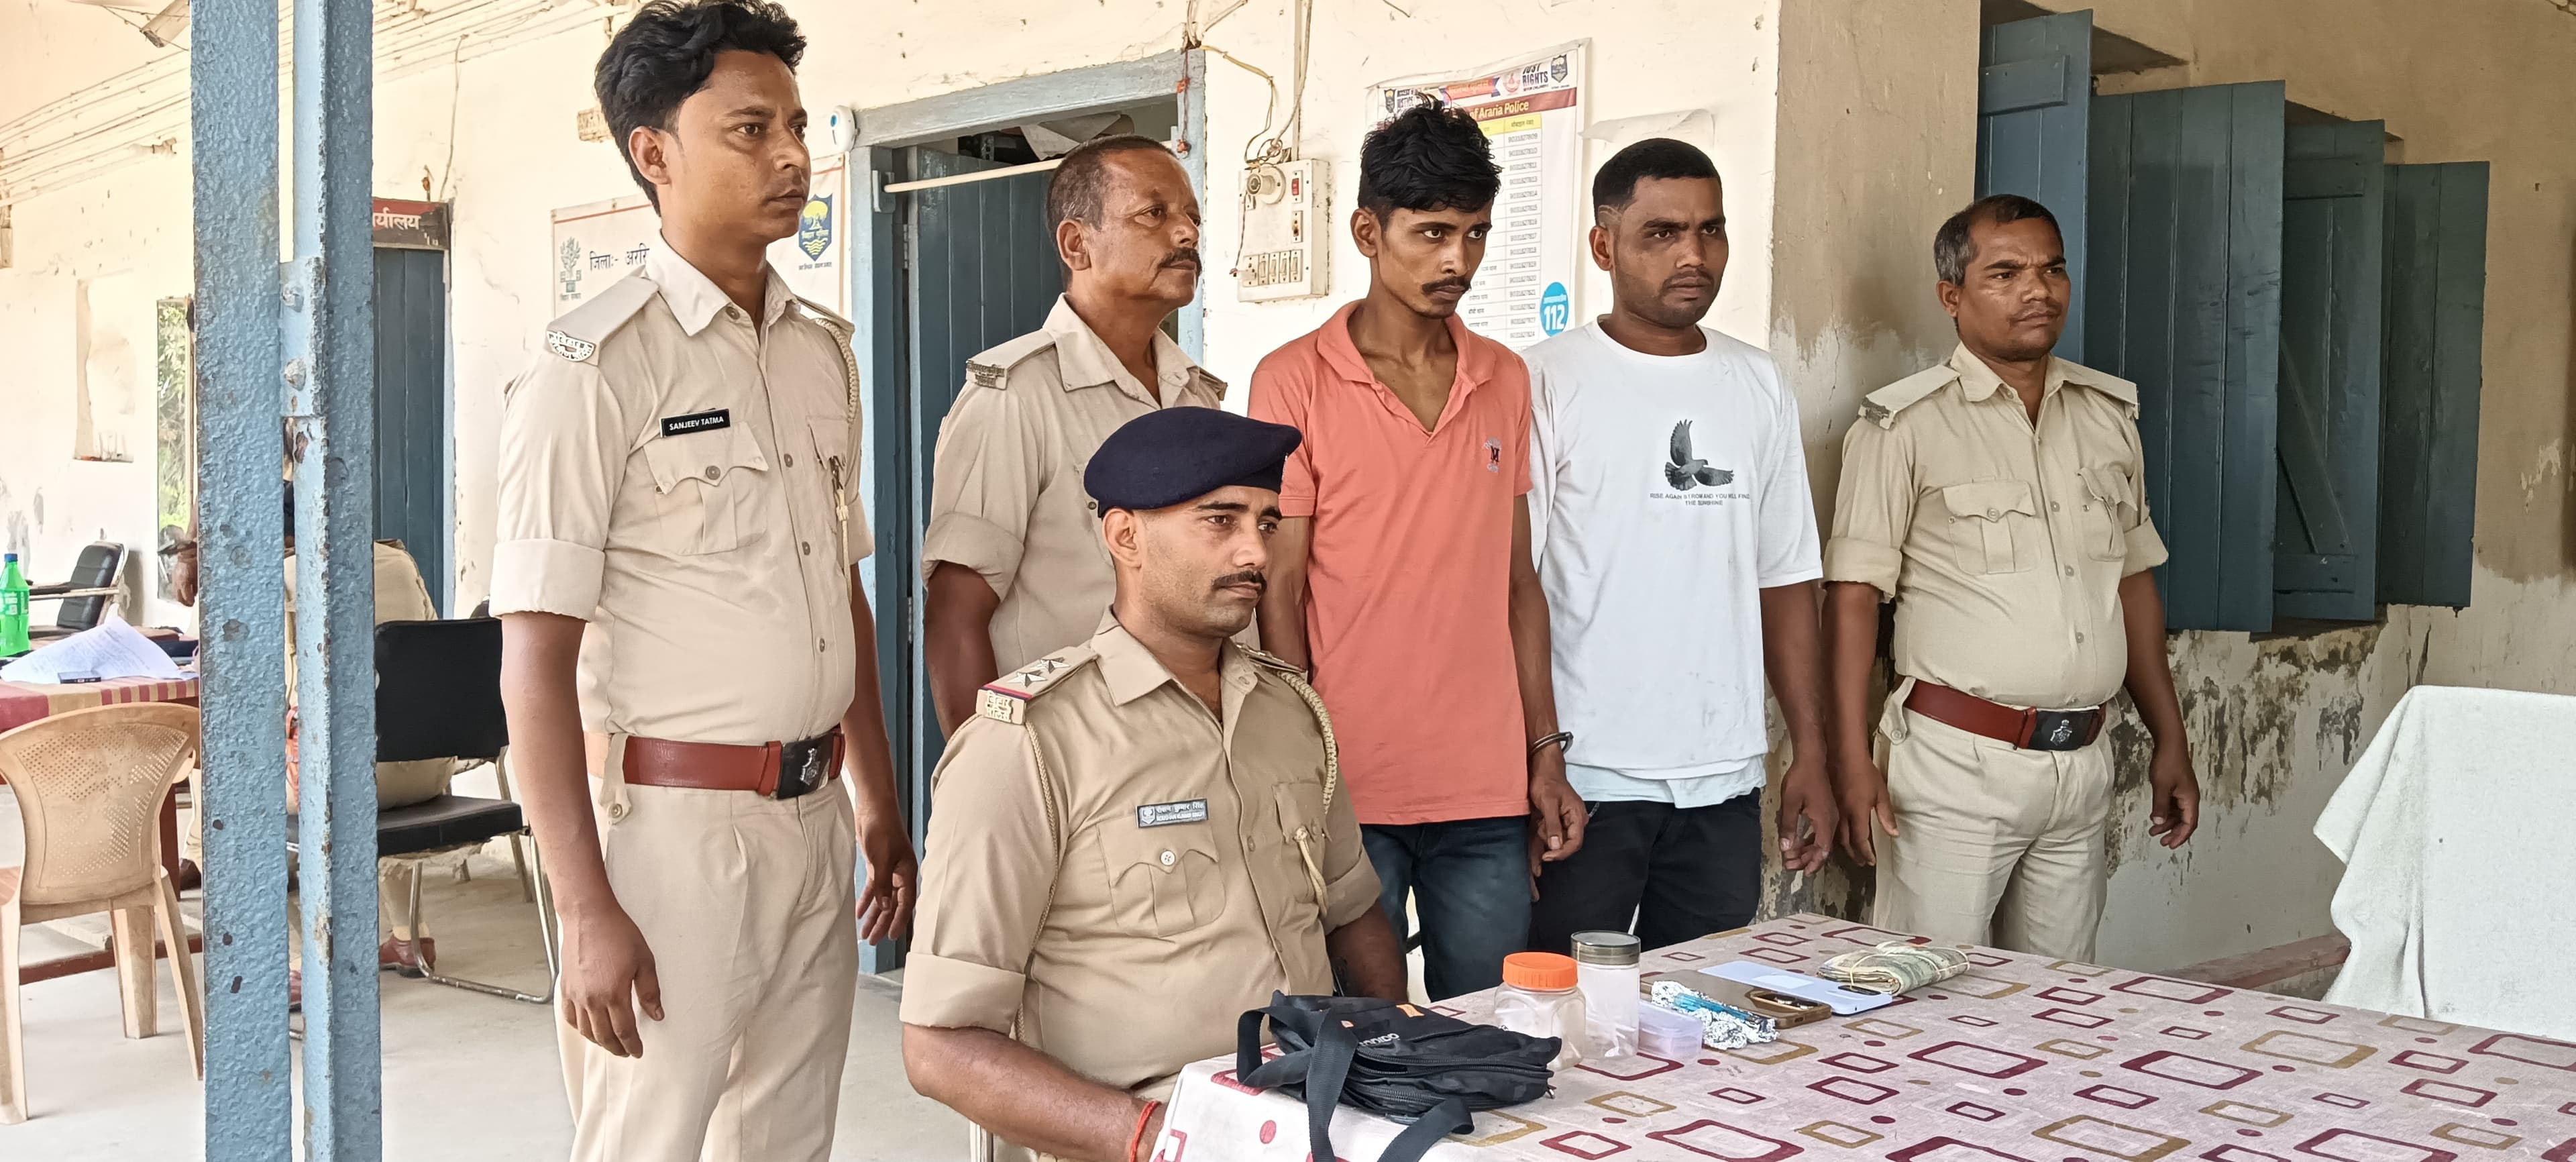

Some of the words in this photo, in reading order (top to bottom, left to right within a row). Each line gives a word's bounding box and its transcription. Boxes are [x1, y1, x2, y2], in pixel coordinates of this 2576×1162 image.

[1521, 71, 1548, 85] RIGHTS
[1470, 109, 1477, 119] of
[1477, 106, 1503, 118] Araria
[1505, 101, 1529, 114] Police
[1544, 304, 1566, 331] 112
[669, 419, 700, 431] SANJEEV
[700, 416, 724, 425] TATMA
